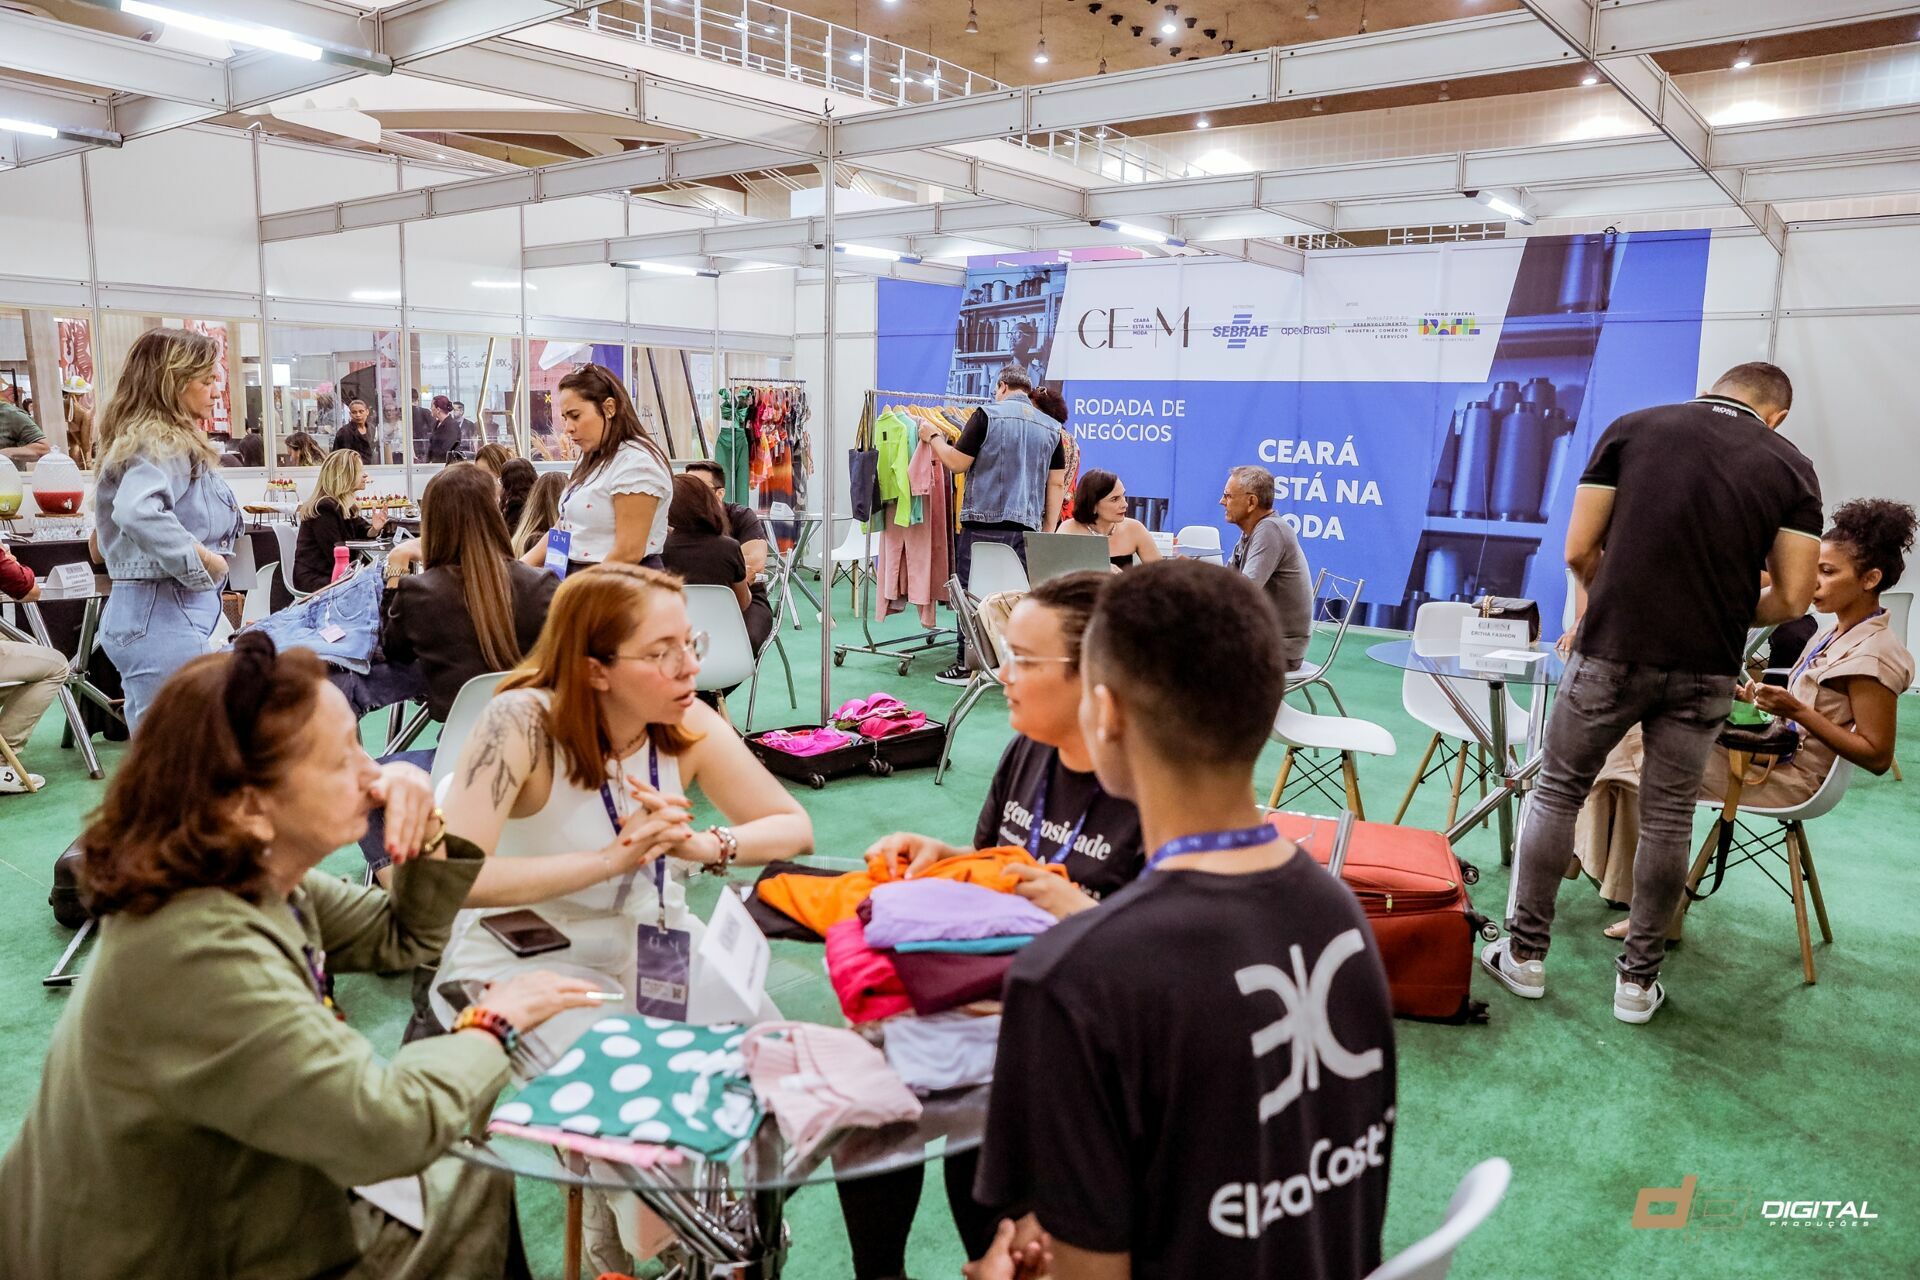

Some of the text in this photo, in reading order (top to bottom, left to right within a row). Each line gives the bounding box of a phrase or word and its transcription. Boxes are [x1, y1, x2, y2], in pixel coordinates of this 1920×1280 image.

[1213, 325, 1269, 338] SEBRAE
[1418, 318, 1480, 335] BRASIL
[1074, 398, 1186, 417] RODADA DE
[1073, 419, 1172, 442] NEGÓCIOS
[1258, 435, 1360, 467] CEARÁ
[1273, 472, 1384, 506] STÁ NA
[1282, 513, 1345, 541] ODA
[1002, 800, 1112, 861] genosiade
